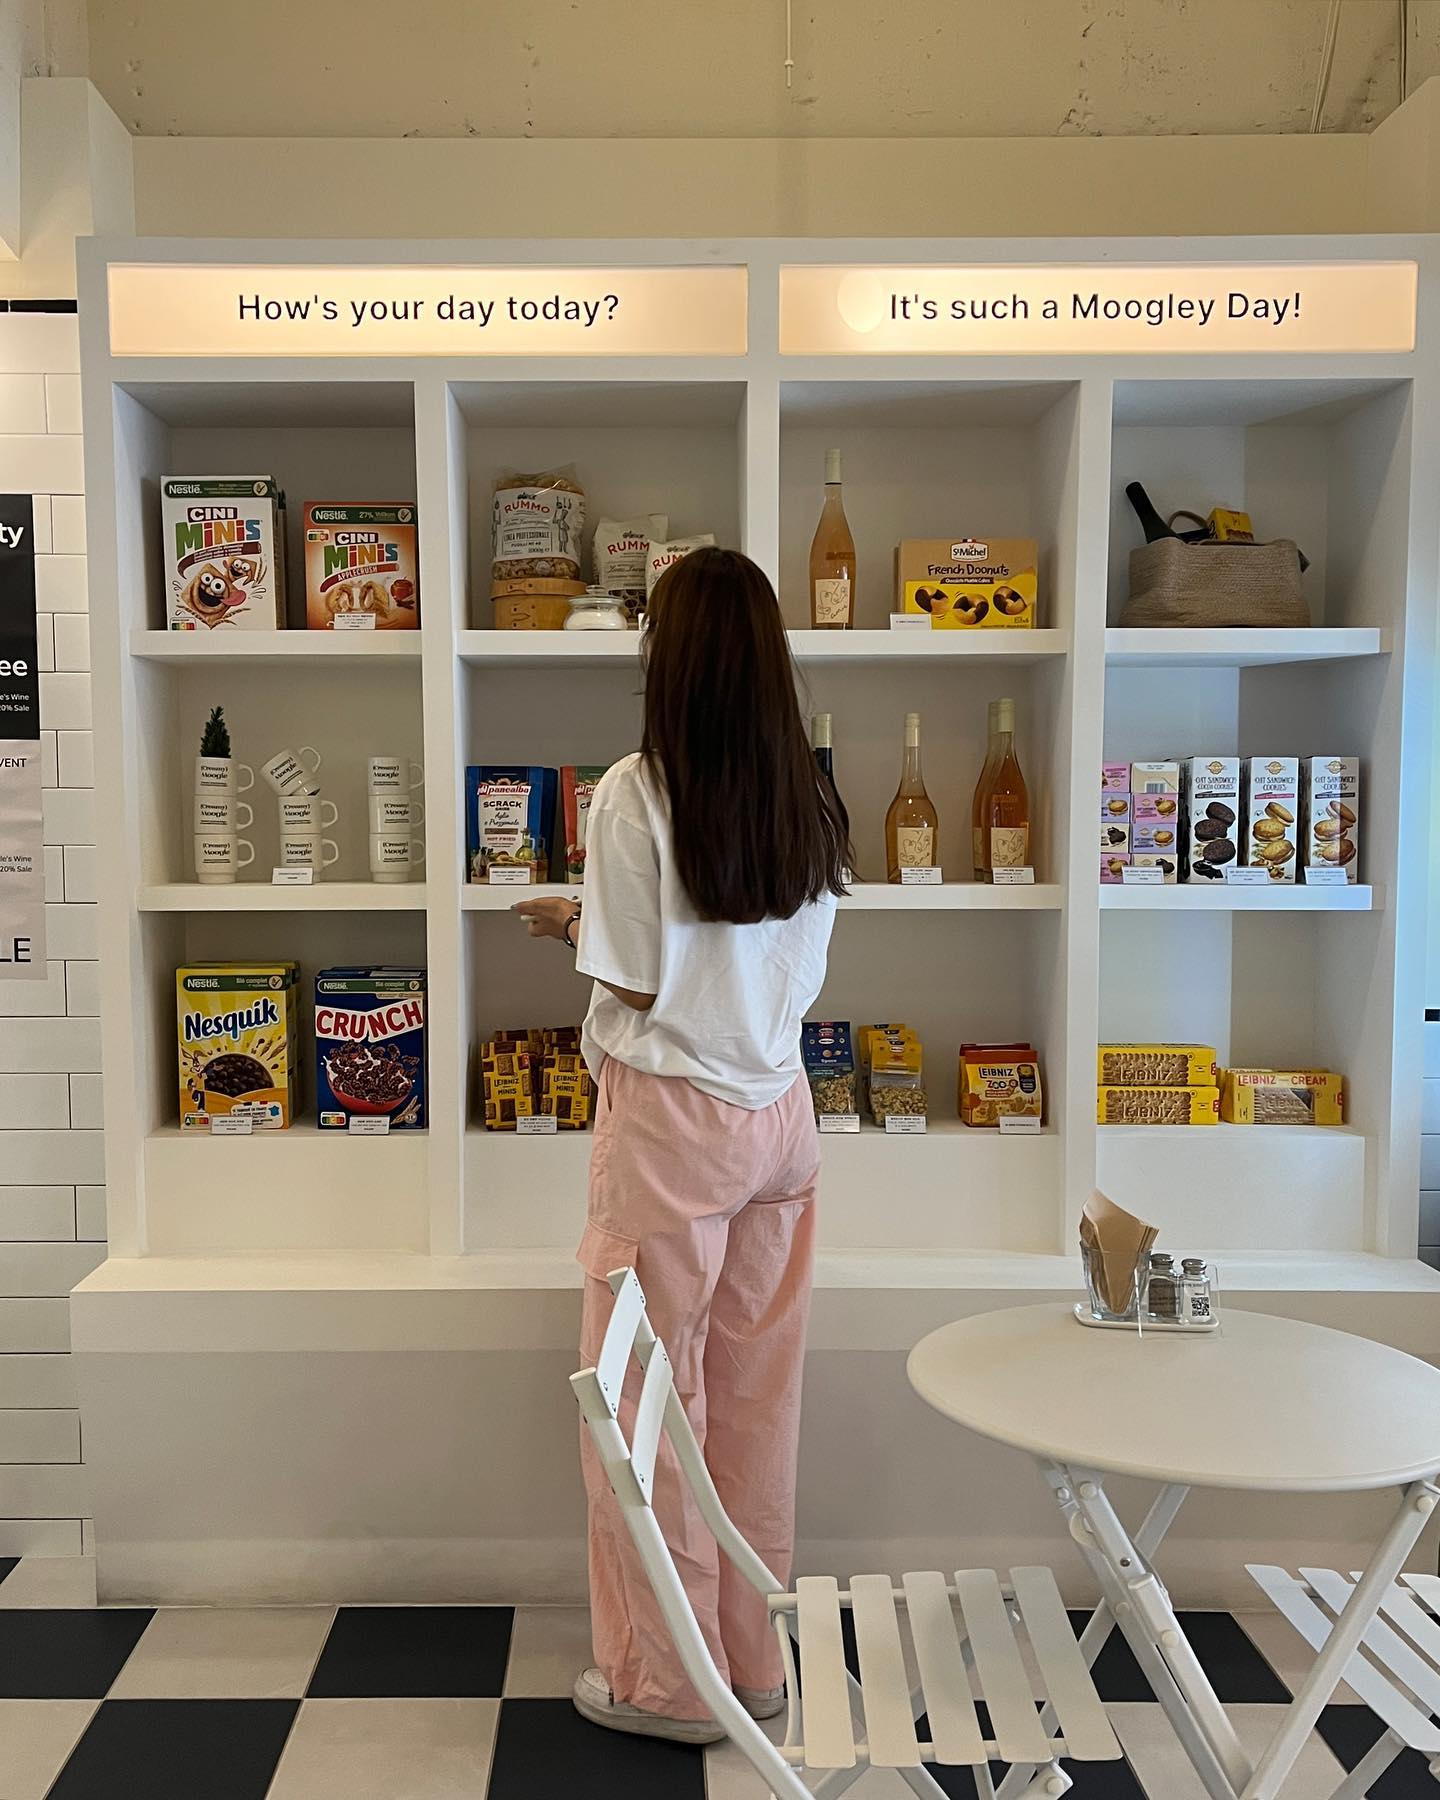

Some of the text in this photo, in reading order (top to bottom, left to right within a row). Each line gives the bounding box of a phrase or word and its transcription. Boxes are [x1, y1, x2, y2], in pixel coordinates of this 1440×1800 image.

[239, 294, 620, 327] How's your day today?
[891, 292, 1301, 326] It's such a Moogley Day!
[504, 500, 551, 514] RUMMO
[190, 507, 236, 521] CINI
[359, 511, 374, 519] 27%
[337, 533, 376, 544] CINI
[607, 540, 650, 555] RUMM
[966, 563, 1009, 576] Doonuts
[10, 693, 30, 701] Wine
[13, 704, 30, 712] Sale
[483, 800, 523, 809] SCRACK
[13, 855, 32, 863] Wine
[16, 865, 33, 873] Sale
[184, 997, 279, 1042] Nesquik
[316, 1001, 423, 1040] CRUNCH
[978, 1066, 1014, 1079] LEIBNIZ
[494, 1078, 520, 1088] LEIBNIZ
[553, 1075, 579, 1083] LEIBNIZ
[987, 1080, 1007, 1089] ZOO
[1238, 1075, 1327, 1086] LEIBNIZ CREAM
